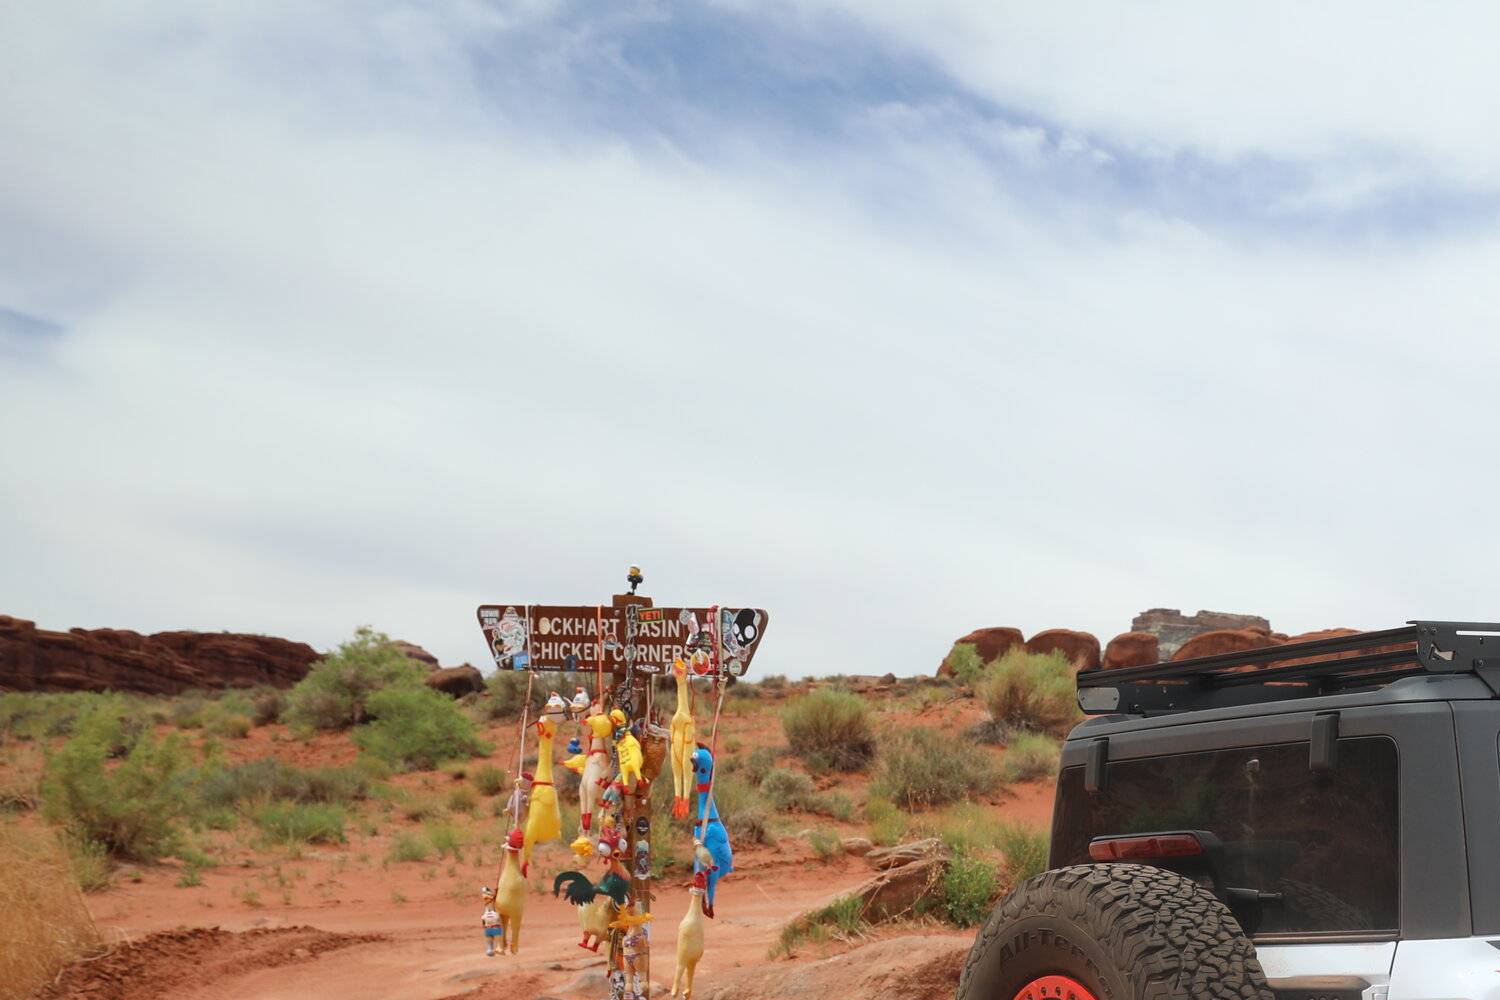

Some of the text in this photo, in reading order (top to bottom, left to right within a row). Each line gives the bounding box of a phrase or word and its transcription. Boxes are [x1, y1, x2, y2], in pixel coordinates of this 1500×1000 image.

[529, 617, 620, 636] LOCKHART
[626, 617, 680, 638] BASIN
[531, 641, 606, 662] CHICKEN
